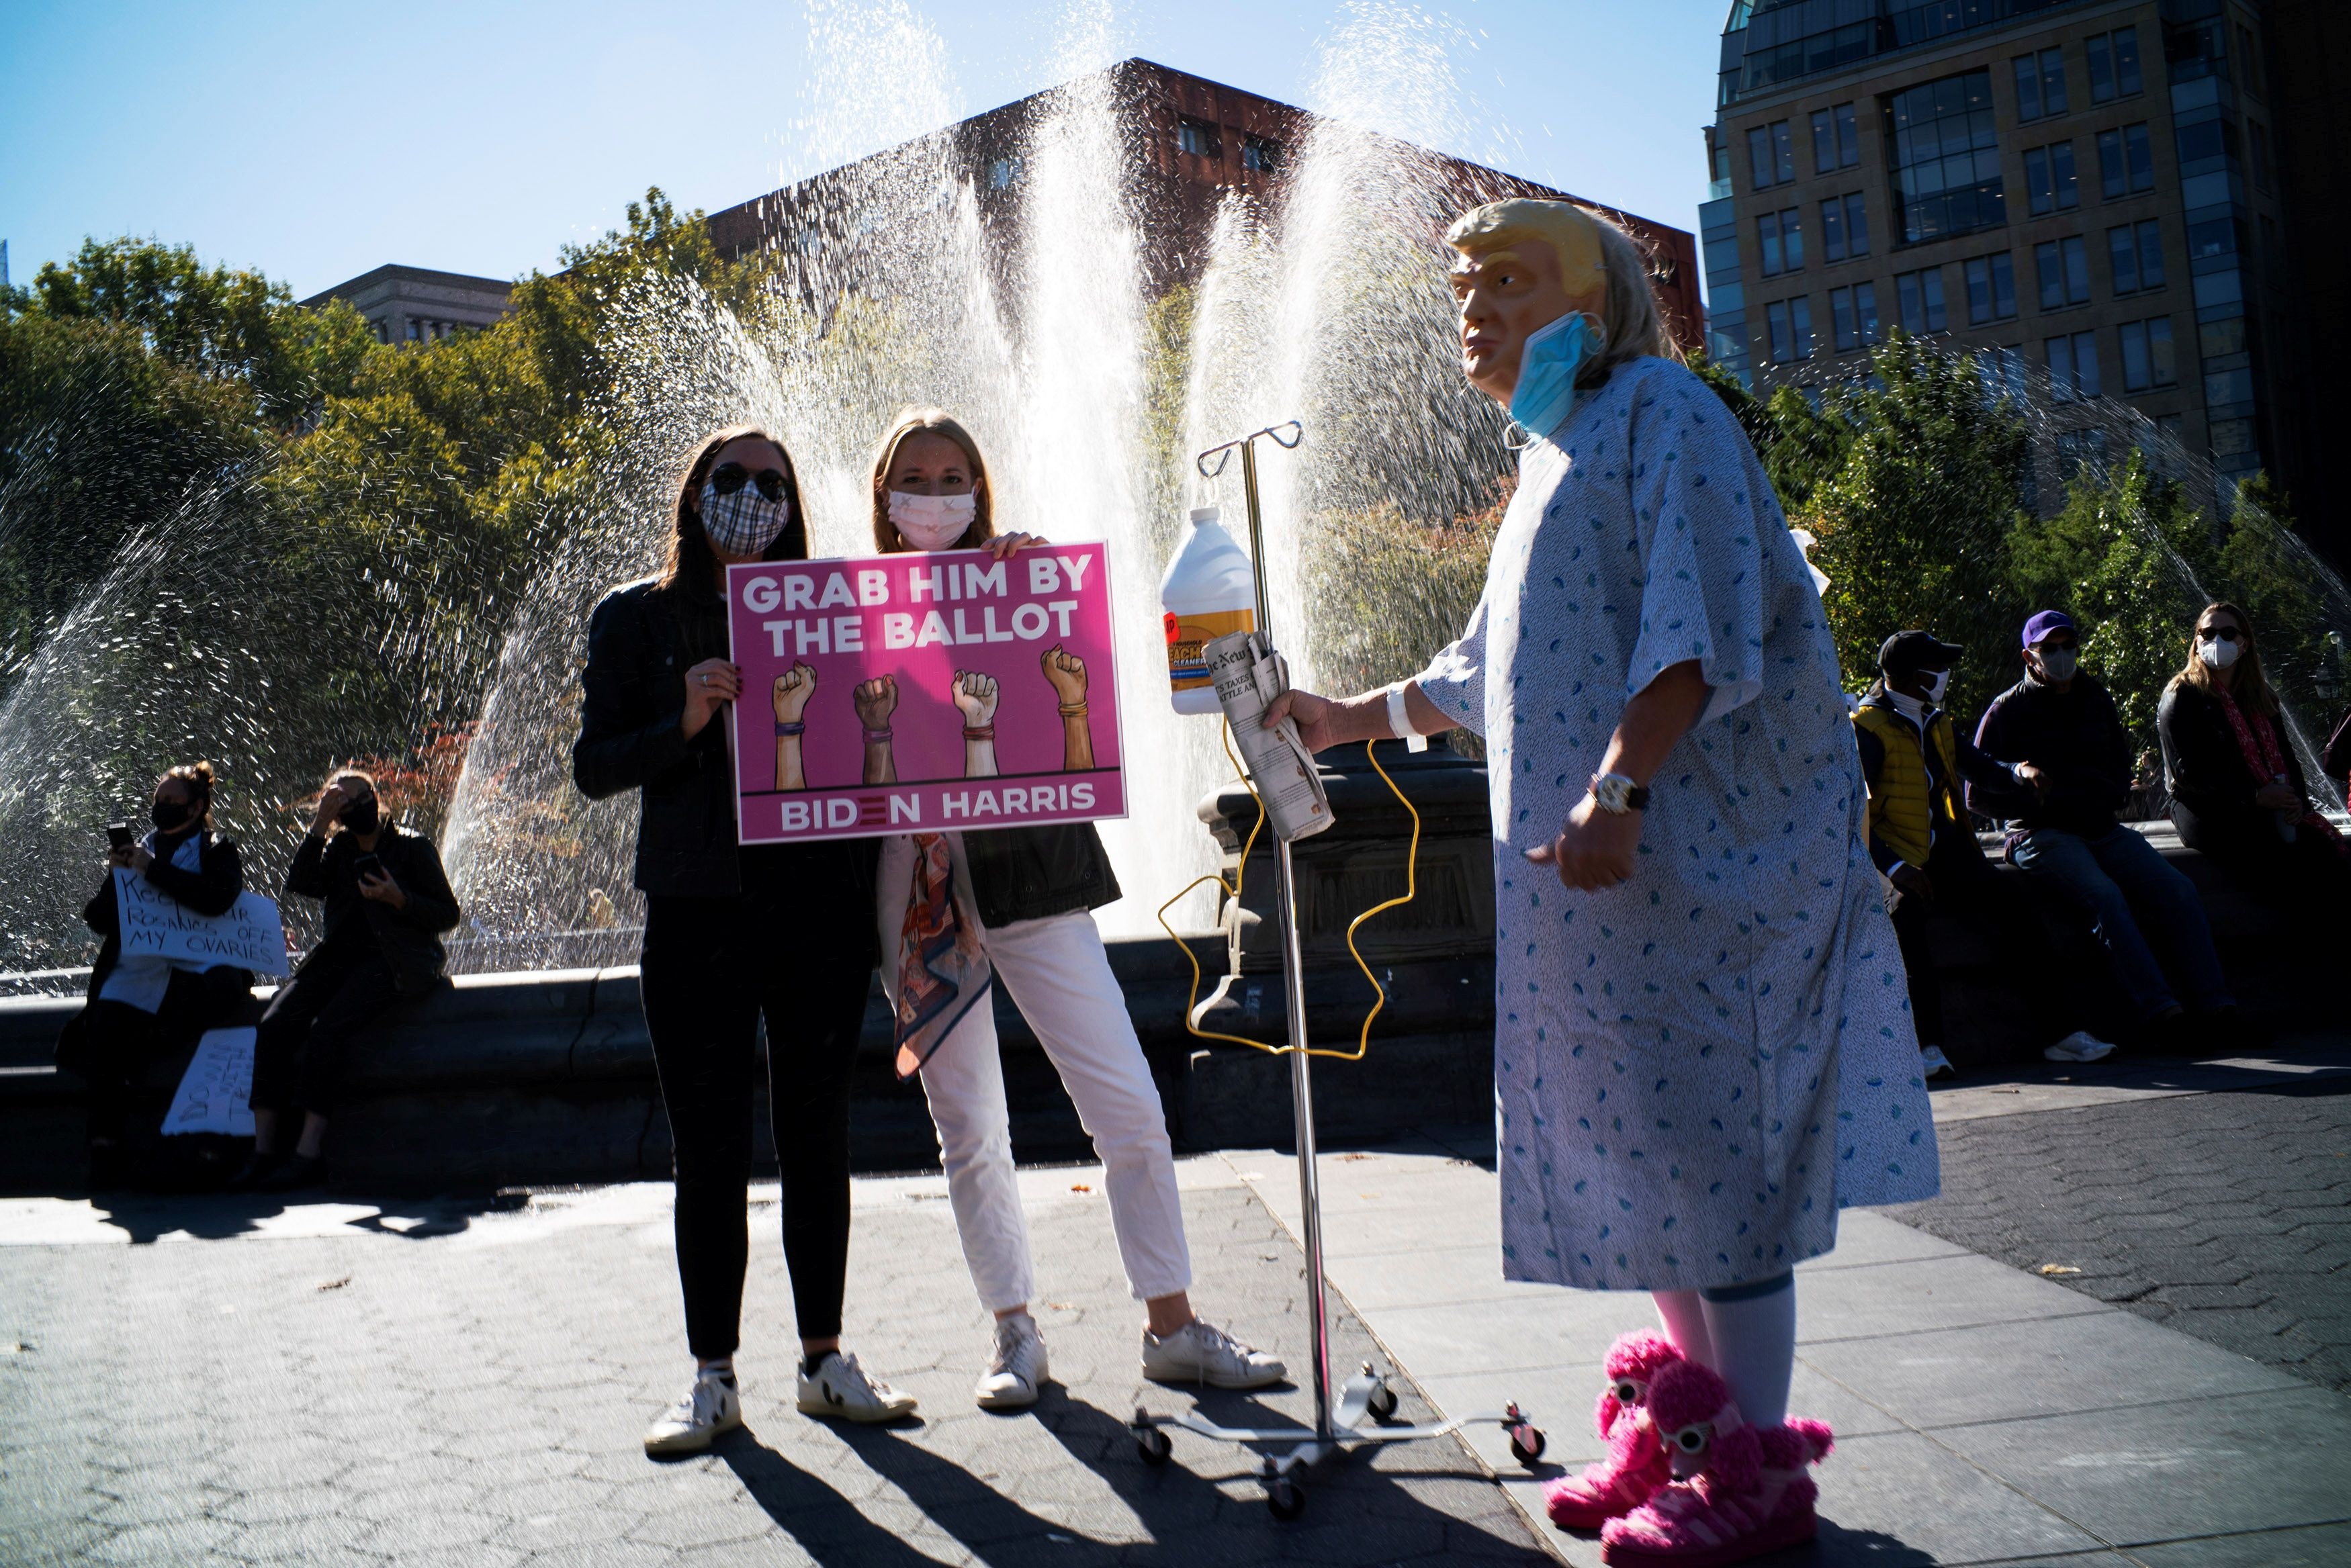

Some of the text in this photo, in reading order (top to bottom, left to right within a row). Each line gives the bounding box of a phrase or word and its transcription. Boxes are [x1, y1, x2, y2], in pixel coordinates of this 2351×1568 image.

[743, 554, 1093, 614] GRAB HIM BY
[763, 600, 1078, 657] THE BALLOT
[1169, 647, 1201, 661] EACH
[1218, 650, 1246, 669] New
[1220, 688, 1243, 703] ATTLE
[1244, 681, 1257, 693] AN
[1225, 674, 1249, 688] TAXES
[781, 782, 1096, 832] BIDEN HARRIS
[238, 926, 273, 943] OFF
[129, 929, 274, 966] MY OVARIES
